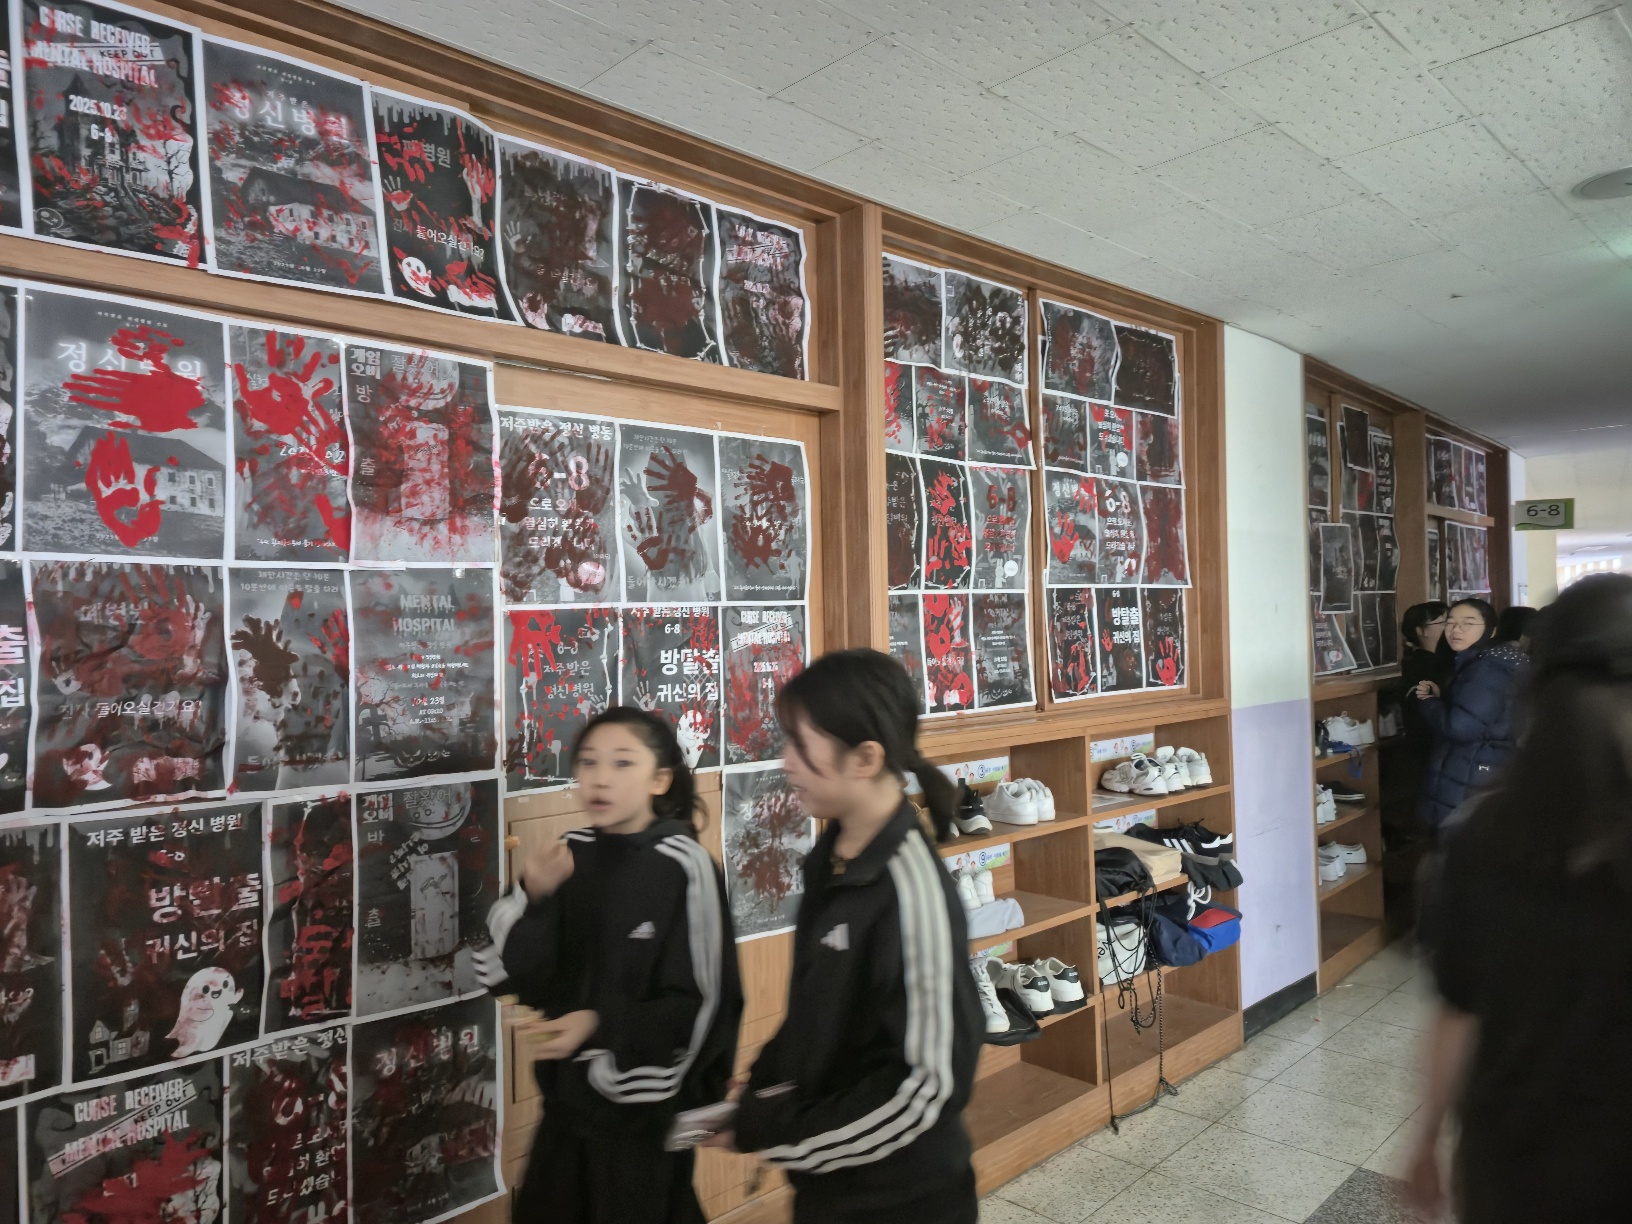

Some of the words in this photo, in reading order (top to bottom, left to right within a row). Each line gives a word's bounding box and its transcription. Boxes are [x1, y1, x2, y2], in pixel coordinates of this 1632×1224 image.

[90, 20, 151, 54] RECEIVED
[91, 53, 158, 88] HOSPITAL
[90, 124, 112, 141] 6-8
[559, 422, 584, 438] 정신
[528, 452, 590, 490] 6-8
[986, 484, 1016, 513] 6-8
[1527, 504, 1560, 516] 6-8
[400, 594, 455, 611] MENTAL
[1112, 606, 1139, 626] 방탈출
[392, 617, 455, 634] HOSPITAL
[664, 623, 681, 634] 6-8
[660, 648, 720, 675] 방탈출
[658, 682, 701, 702] 귀신의
[705, 681, 719, 701] 집
[87, 829, 125, 847] 저주
[130, 825, 166, 844] 받은
[172, 818, 205, 838] 정신
[210, 813, 245, 833] 병원
[146, 930, 225, 964] 귀신의
[233, 1037, 310, 1068] 저주받은
[74, 1094, 118, 1123] CURSE
[125, 1077, 184, 1110] RECEIVED
[127, 1109, 190, 1146] HOSPITAL
